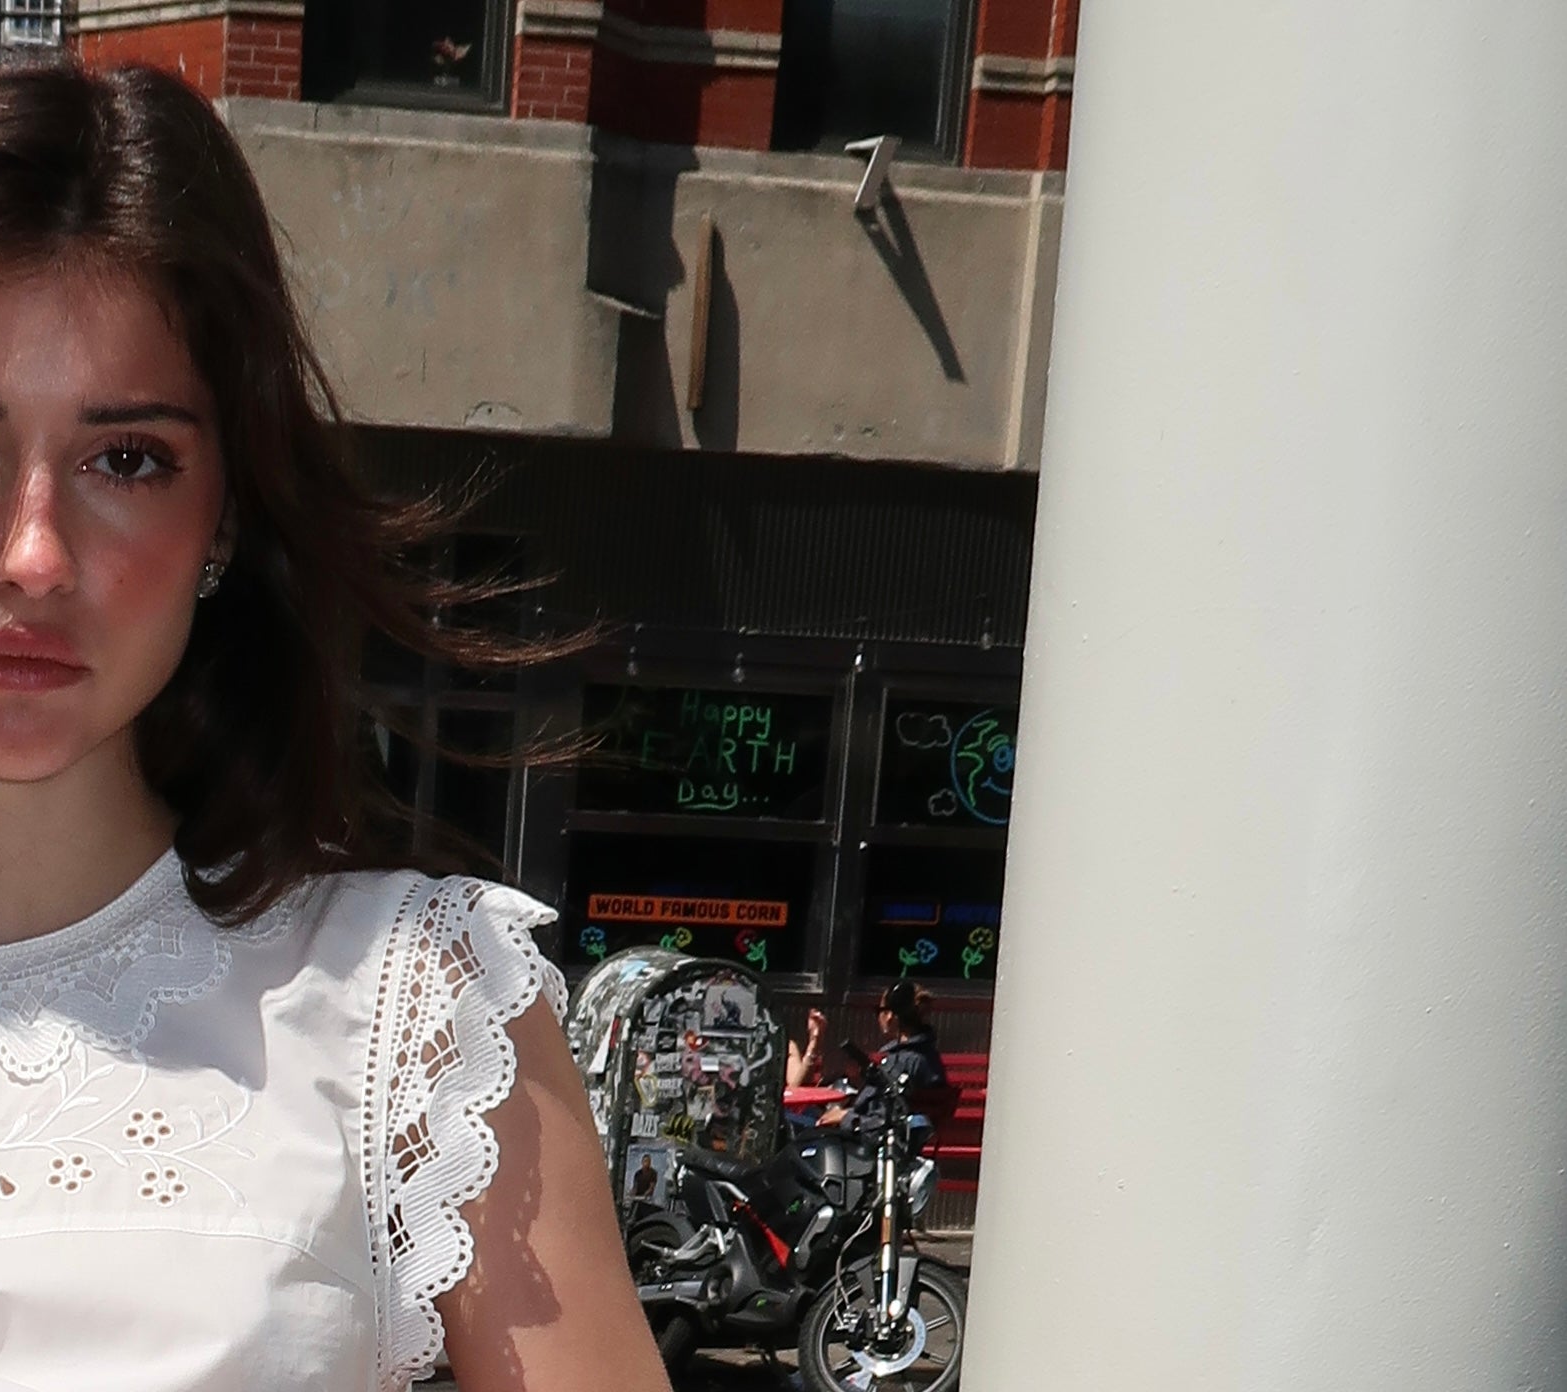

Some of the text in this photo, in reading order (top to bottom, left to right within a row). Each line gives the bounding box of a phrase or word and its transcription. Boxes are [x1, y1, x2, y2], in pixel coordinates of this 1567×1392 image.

[680, 690, 774, 739] Happy
[641, 729, 797, 776] EARTH
[594, 896, 781, 921] WORLD FAMOUS CORN
